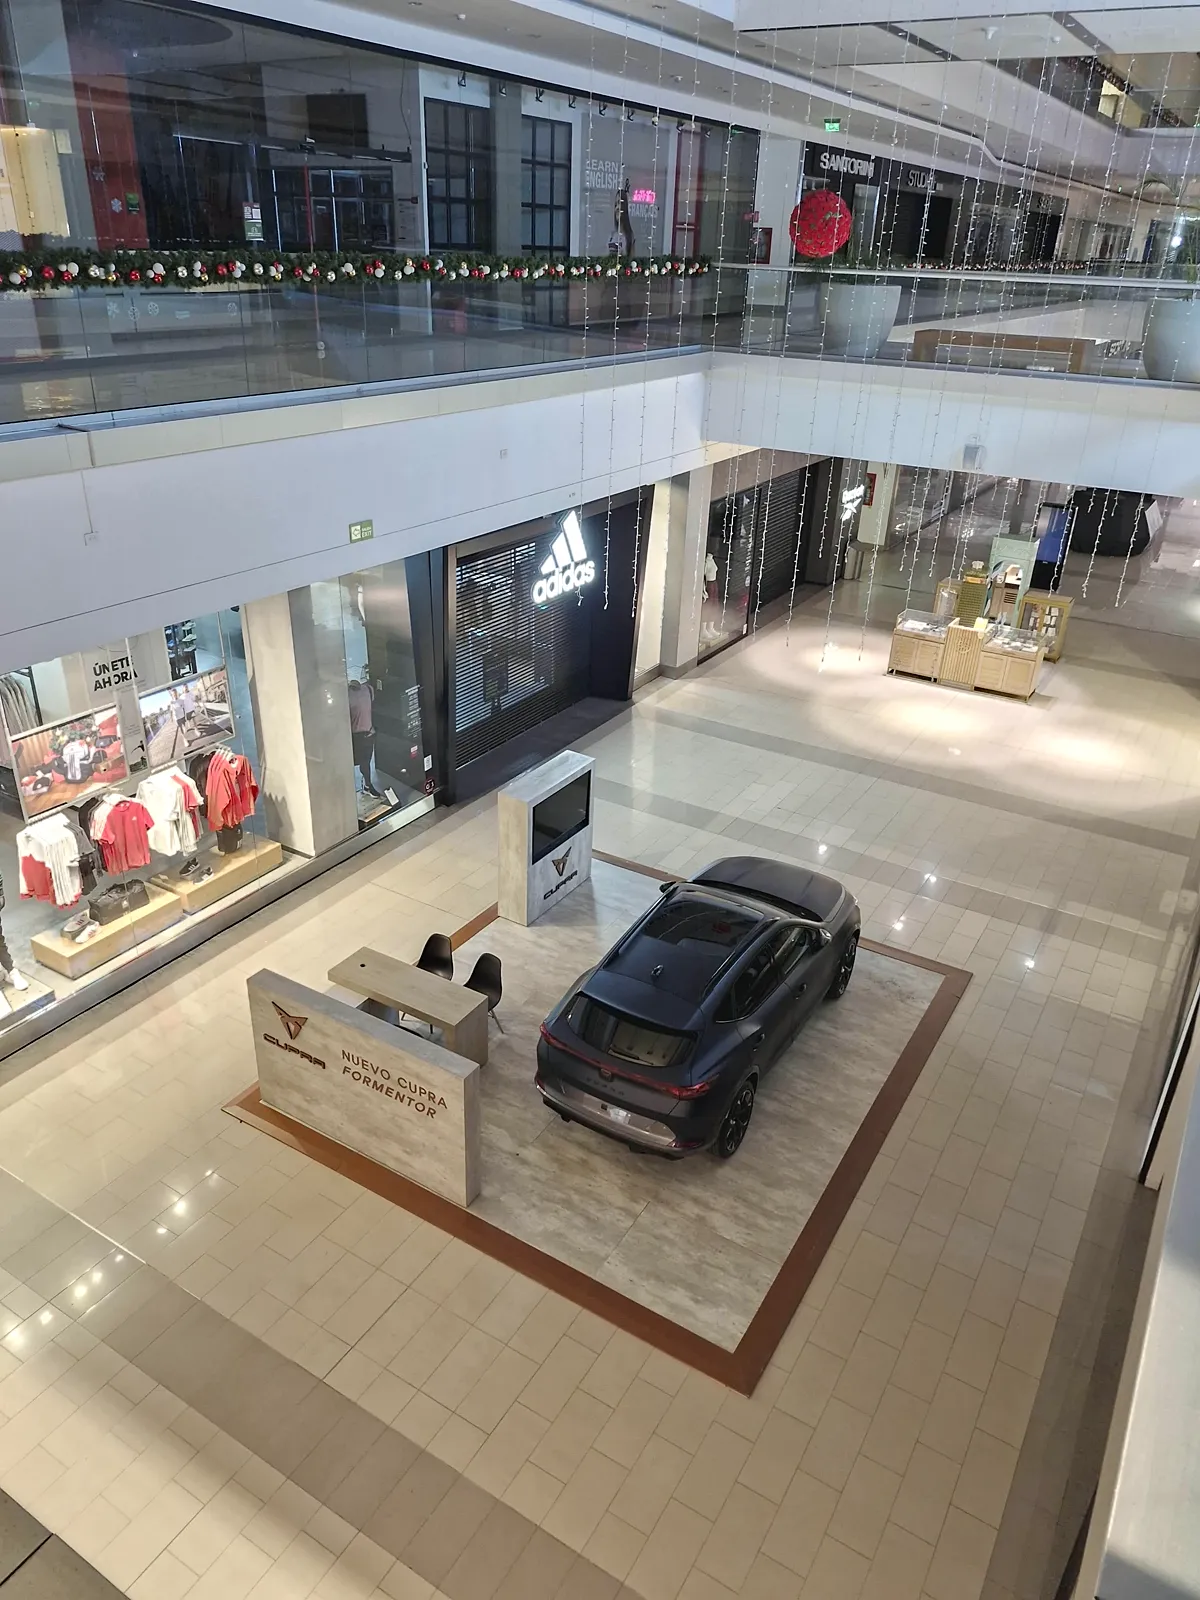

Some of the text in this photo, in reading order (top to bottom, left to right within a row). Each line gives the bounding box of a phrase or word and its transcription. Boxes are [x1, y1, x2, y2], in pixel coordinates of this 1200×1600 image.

[585, 170, 618, 190] ENGLISH
[586, 159, 619, 173] LEARN
[820, 152, 875, 178] SANTORINI
[532, 560, 596, 604] adidas
[93, 668, 139, 692] AHORA
[263, 1033, 326, 1070] CUPRA
[341, 1049, 448, 1110] NUEVO CUPRA
[342, 1065, 437, 1119] FORMENTOR
